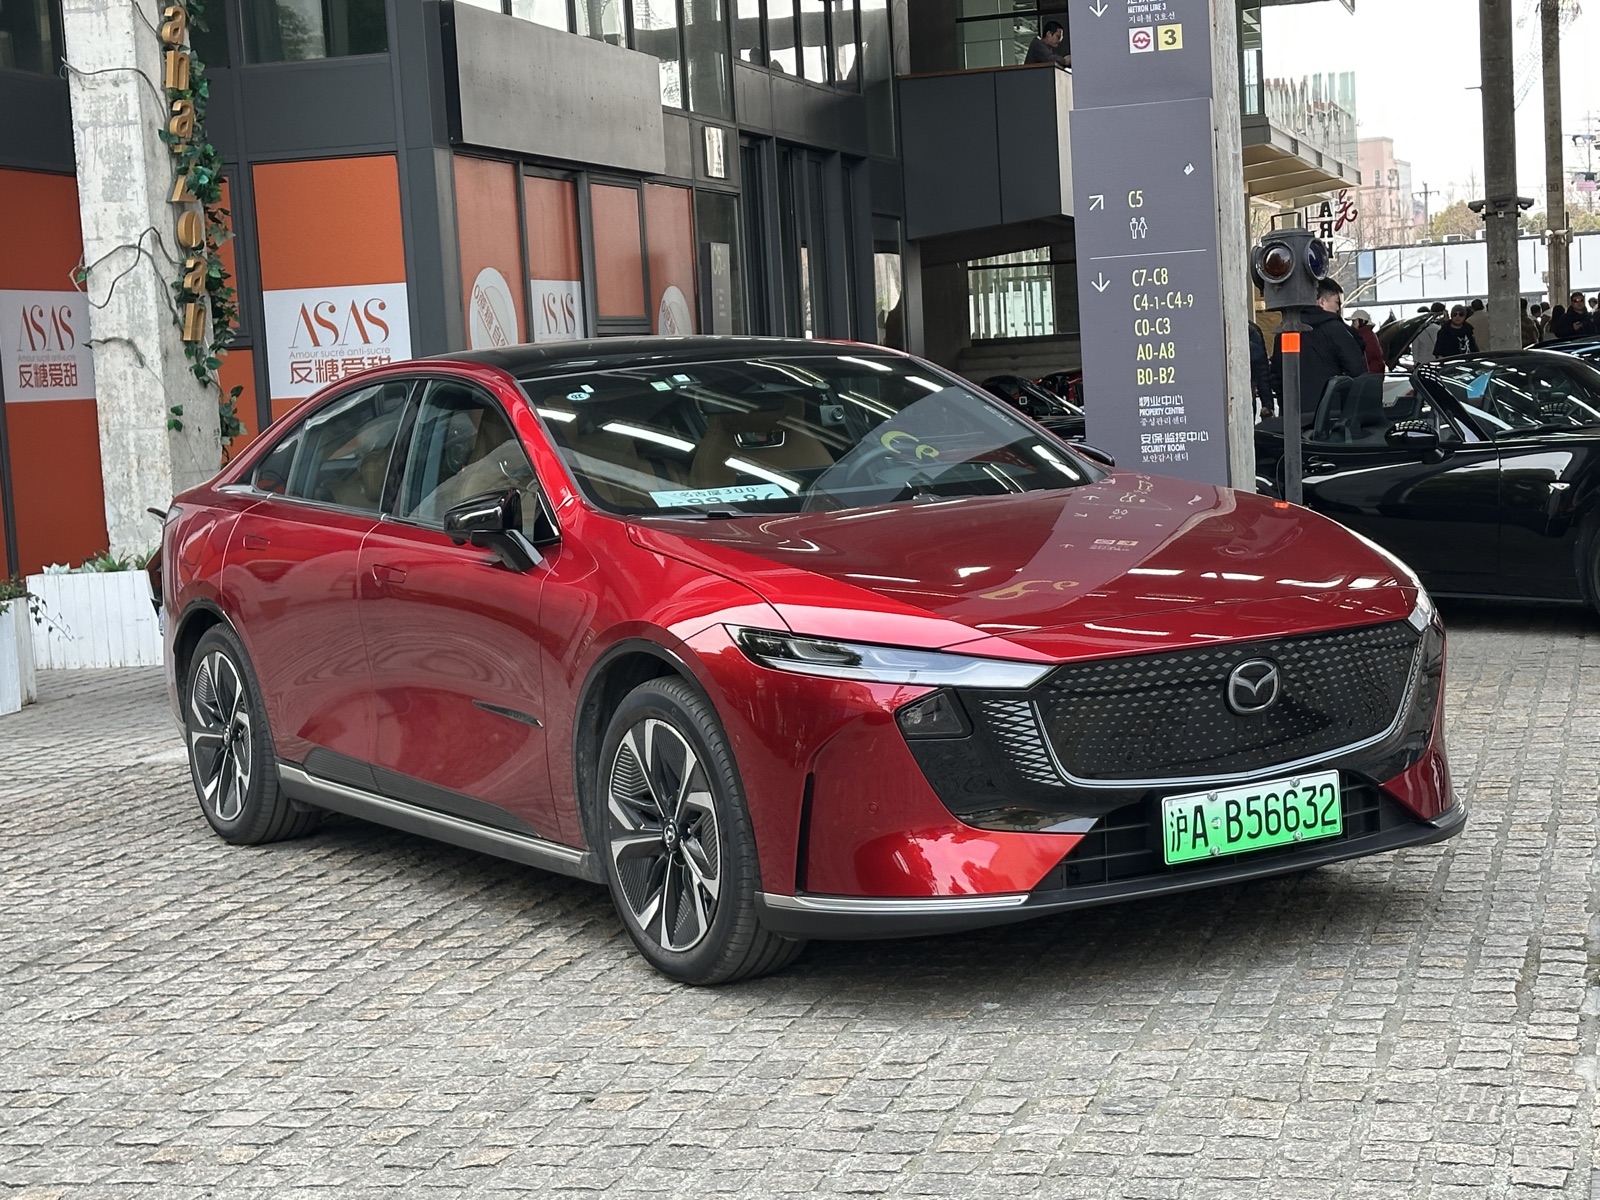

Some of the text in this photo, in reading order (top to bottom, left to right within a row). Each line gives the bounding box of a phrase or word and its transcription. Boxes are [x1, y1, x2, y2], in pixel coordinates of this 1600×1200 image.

[1150, 3, 1161, 11] LINE
[1164, 29, 1176, 45] 3
[1128, 191, 1143, 208] C5
[1132, 267, 1169, 287] C7-C8
[1133, 291, 1194, 312] C4-1-C4-9
[288, 298, 390, 348] ASAS
[1134, 317, 1171, 337] C0-C3
[288, 350, 319, 359] Amour
[1136, 342, 1176, 361] A0-A8
[19, 362, 79, 389] 反糖爱甜
[1137, 367, 1176, 386] B0-B2
[1138, 394, 1184, 407] 物业中心
[1139, 406, 1185, 417] PROPERTY CENTRE
[1140, 430, 1210, 445] 安保监控中心
[1141, 443, 1186, 454] SECURITY ROOM
[1225, 783, 1338, 844] B56632
